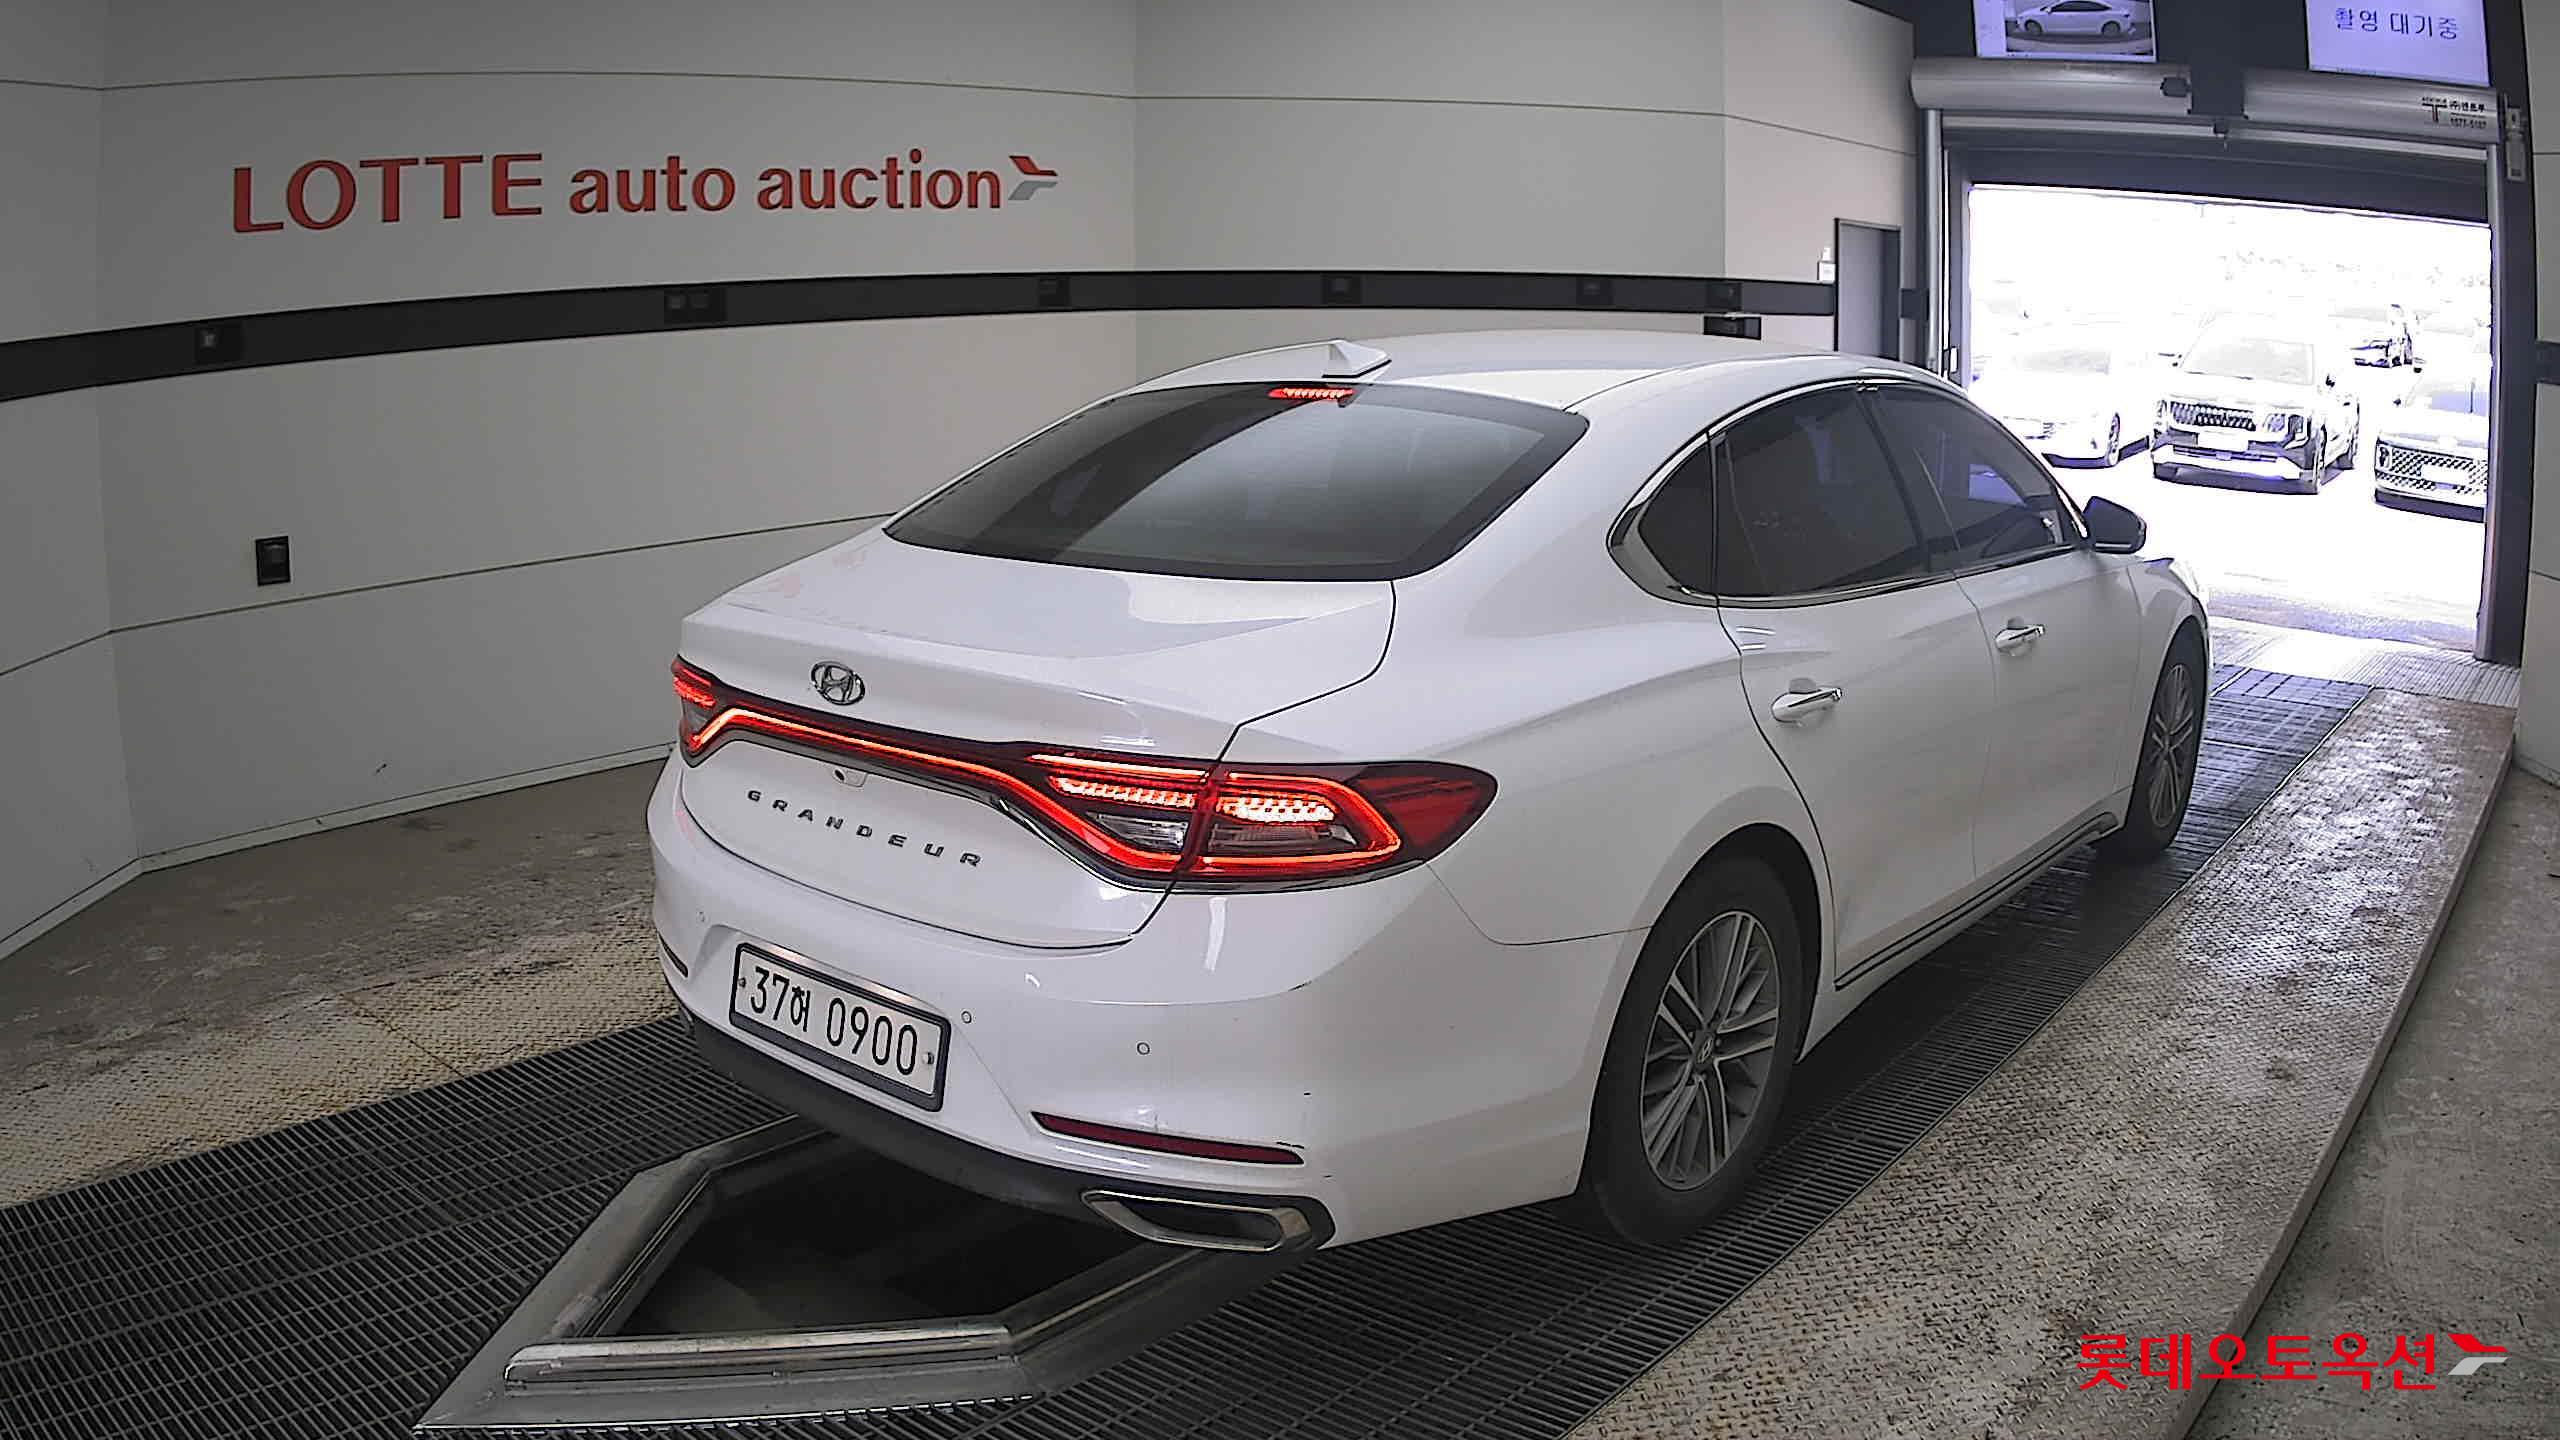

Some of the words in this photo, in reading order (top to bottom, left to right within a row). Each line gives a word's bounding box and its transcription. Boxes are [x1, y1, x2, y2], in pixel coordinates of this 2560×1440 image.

[2336, 8, 2378, 32] 촬영
[2390, 13, 2458, 41] 대기중
[234, 153, 543, 234] LOTTE
[569, 156, 736, 215] auto
[757, 149, 1001, 211] auction
[747, 790, 982, 868] GRANDEUR
[750, 965, 812, 1033] 37허
[826, 997, 918, 1076] 0900
